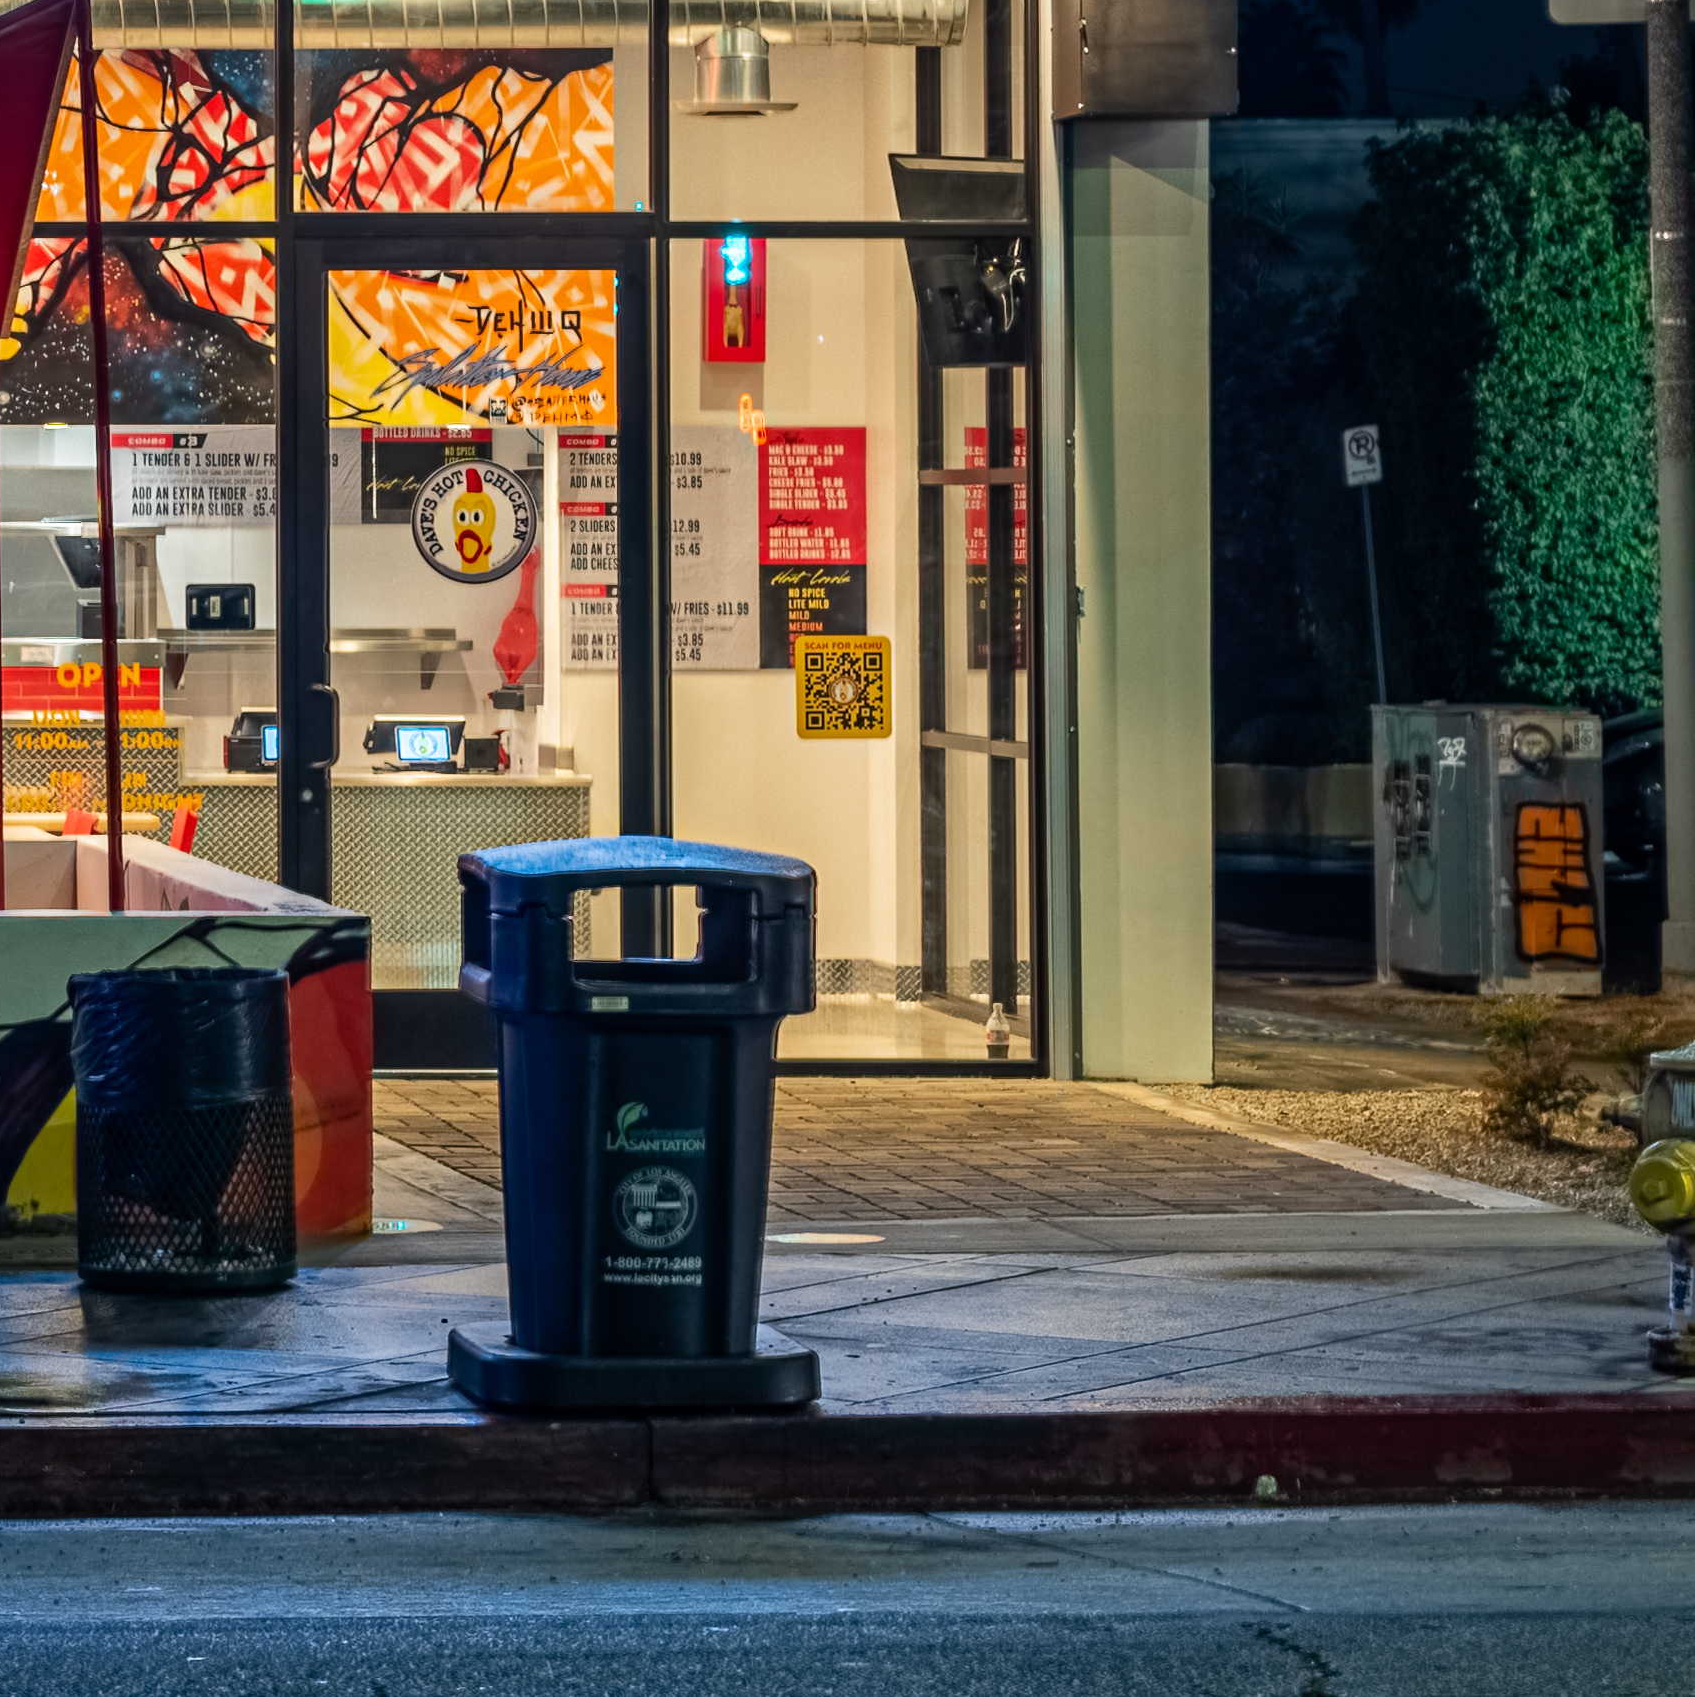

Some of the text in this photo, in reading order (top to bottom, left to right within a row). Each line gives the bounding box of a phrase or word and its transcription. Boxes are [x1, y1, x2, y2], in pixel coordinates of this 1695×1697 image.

[143, 453, 180, 466] TENDER
[195, 453, 201, 466] 1
[205, 453, 241, 466] SLIDER
[244, 453, 260, 466] W/
[570, 453, 576, 465] 2
[579, 453, 617, 465] TENDERS
[570, 476, 587, 488] ADD
[591, 476, 602, 488] AN
[677, 475, 702, 488] $3.85
[132, 487, 152, 500] ADD
[156, 487, 169, 500] AN
[173, 487, 204, 500] EXTRA
[209, 487, 246, 500] TENDER
[132, 503, 152, 516] ADD
[156, 503, 169, 516] AN
[173, 503, 204, 516] EXTRA
[209, 503, 243, 516] SLIDER
[420, 470, 529, 556] DAVE'S HOT CHICKEN
[571, 520, 700, 533] 2 SLIDERS 12.99
[571, 543, 587, 555] ADD
[591, 543, 603, 555] AN
[675, 543, 700, 556] $5.45
[571, 558, 618, 570] ADD CHEES
[789, 588, 826, 598] NO SPICE
[580, 603, 613, 615] TENDER
[684, 603, 709, 615] FRIES
[717, 603, 749, 615] $11.99
[789, 599, 830, 609] LITE MILD
[789, 610, 810, 620] MILD
[789, 622, 823, 631] MEDIUM
[571, 634, 588, 646] ADD
[592, 634, 603, 646] AN
[677, 633, 703, 646] $3.85
[805, 642, 882, 650] SCAN FOR MENU
[571, 649, 588, 661] ADD
[592, 649, 603, 661] AN
[675, 649, 701, 662] $5.45
[56, 662, 140, 688] OPN
[629, 1139, 706, 1151] SANITATION
[647, 1167, 662, 1175] LOS
[665, 1169, 693, 1195] ANGELES
[604, 1273, 702, 1285] www.lacitysan.org
